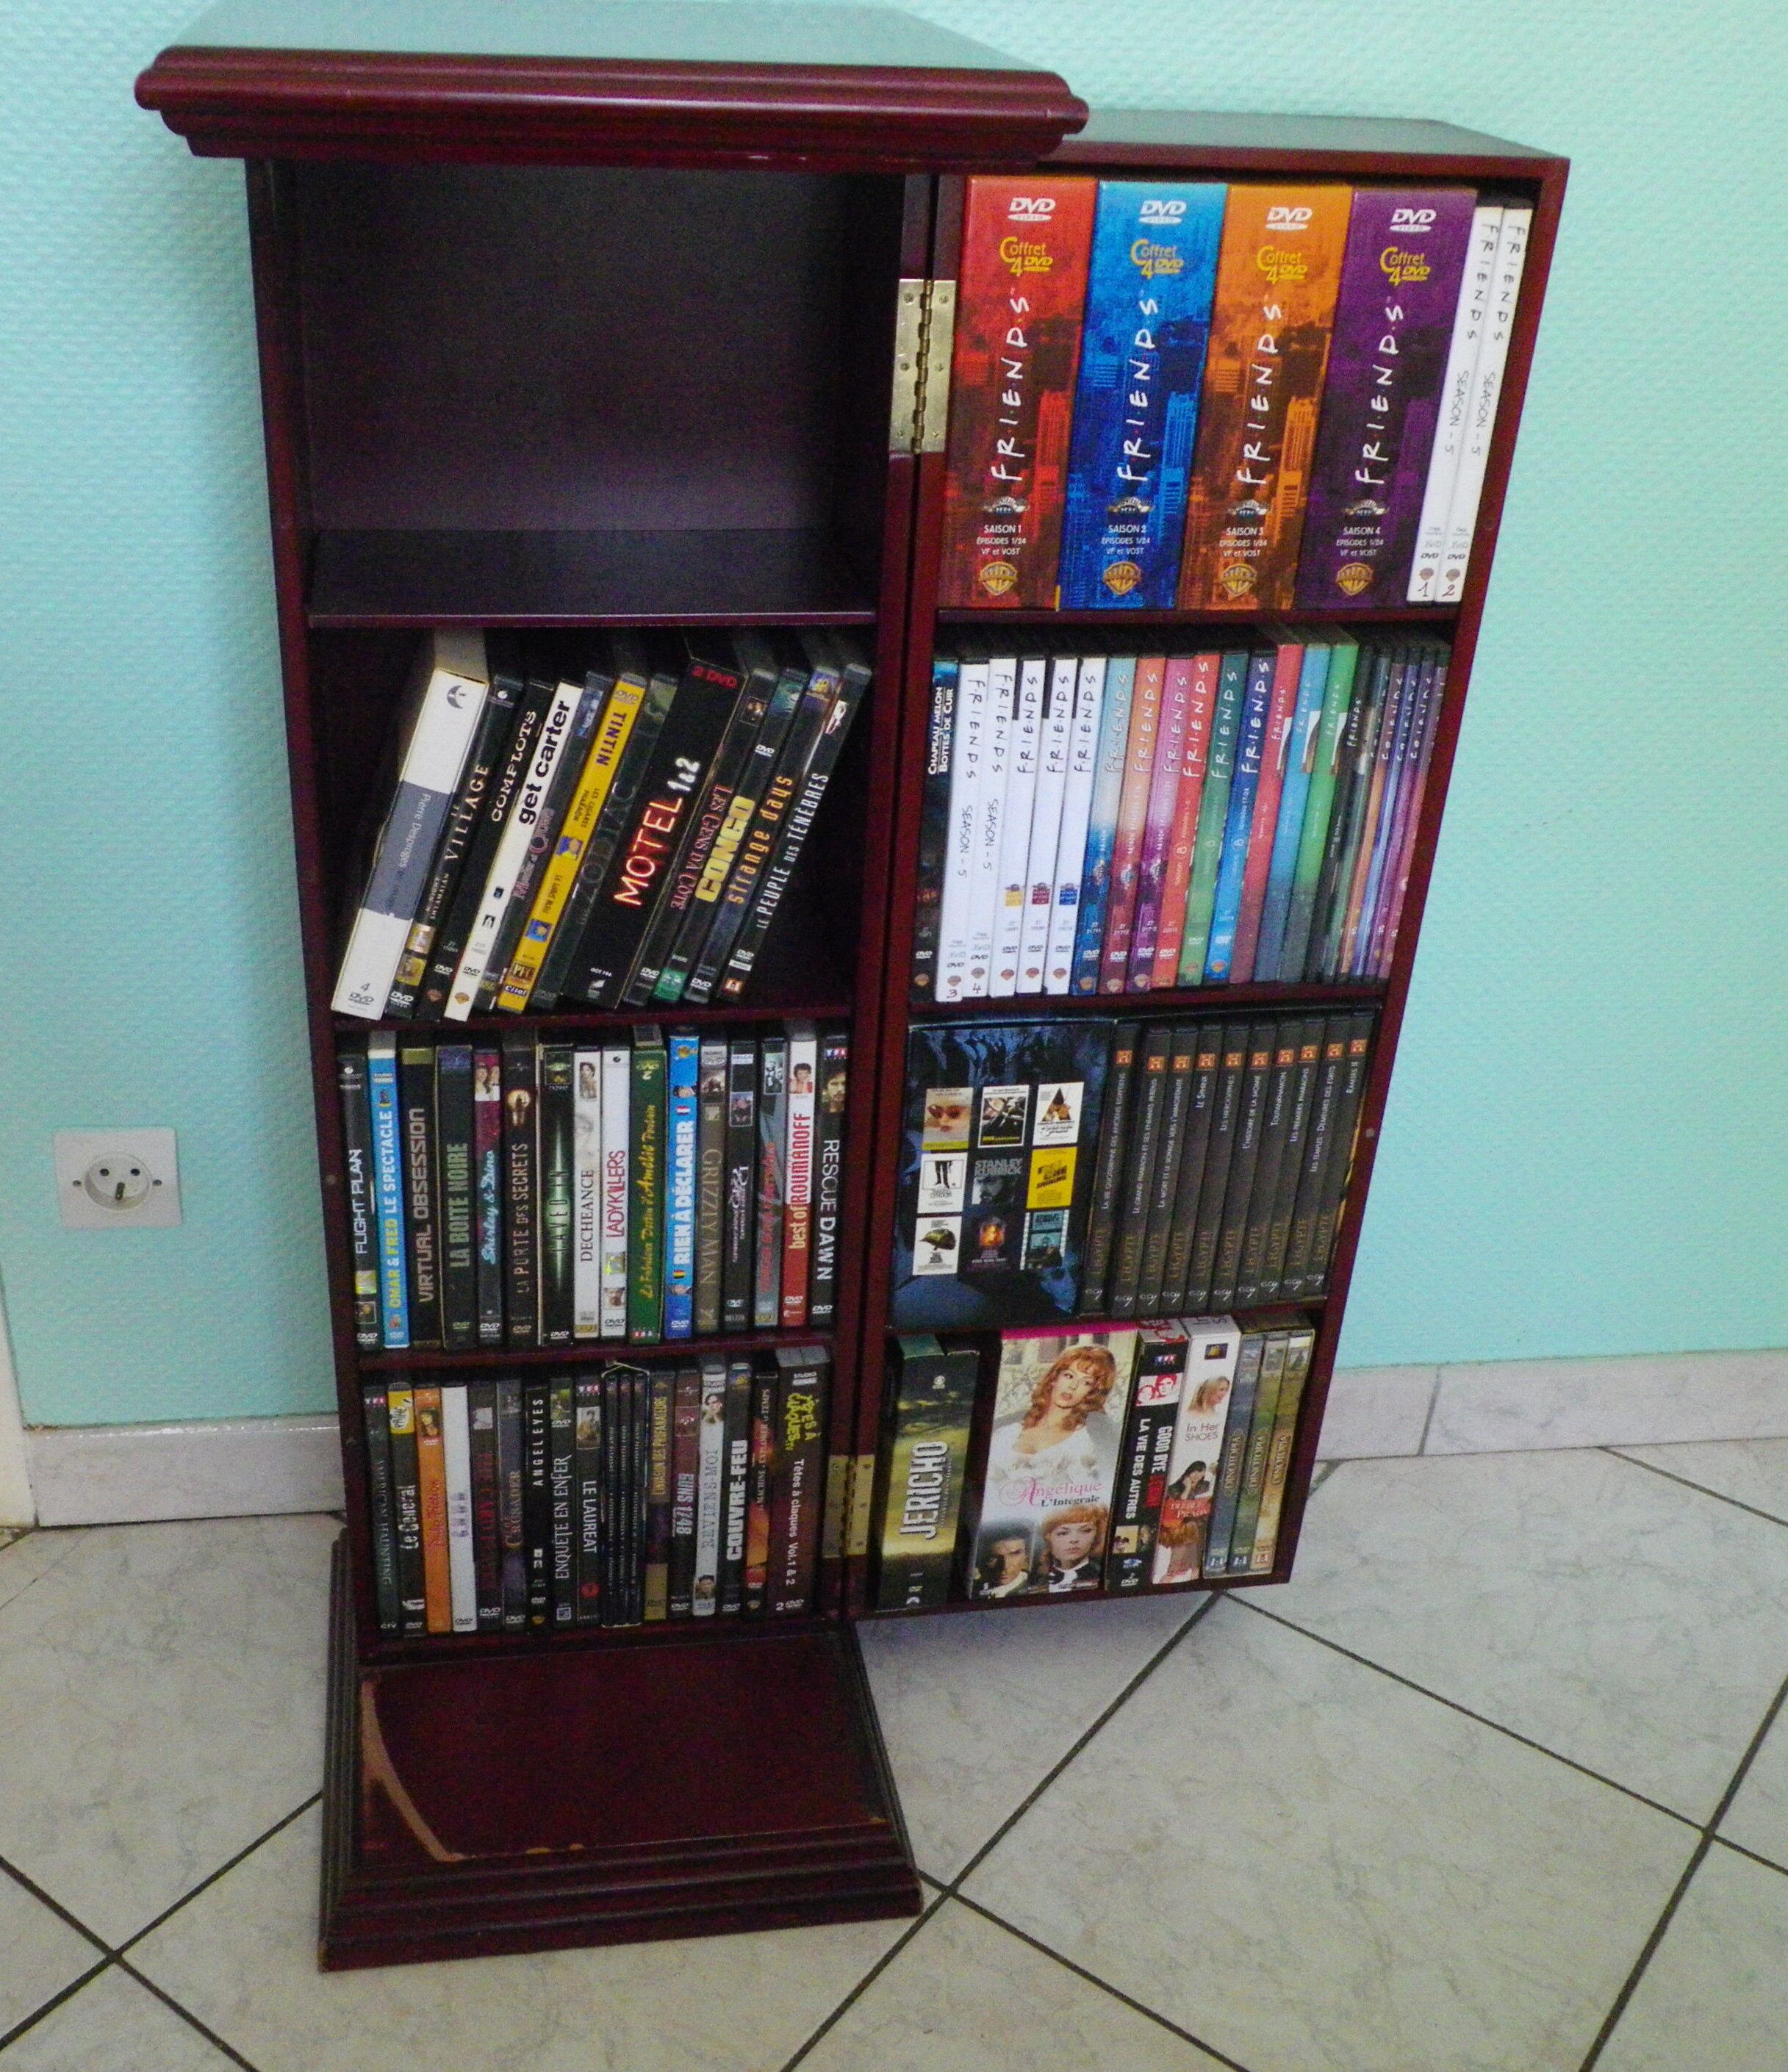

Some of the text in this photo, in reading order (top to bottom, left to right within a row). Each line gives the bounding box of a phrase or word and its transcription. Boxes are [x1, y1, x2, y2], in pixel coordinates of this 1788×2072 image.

[1008, 197, 1056, 212] DVD
[1141, 200, 1187, 215] DVD
[1267, 206, 1313, 222] DVD
[1391, 209, 1437, 224] DVD
[1000, 237, 1047, 262] Coffret
[1130, 239, 1178, 265] Coffret
[1256, 245, 1302, 272] Coffret
[1380, 247, 1425, 273] Coffret
[983, 524, 1022, 533] SAISON 1
[1107, 524, 1147, 533] SAISON 2
[1226, 526, 1257, 536] SAISON
[1343, 526, 1374, 536] SAISON
[981, 547, 1020, 555] VF et VOST
[1106, 547, 1144, 555] VF et VOST
[1242, 549, 1261, 558] VOST
[1340, 549, 1377, 557] VF VOST
[1418, 583, 1429, 597] 1
[1442, 583, 1456, 597] 2
[595, 711, 627, 766] TINTIN
[927, 686, 943, 775] CHAPEAU MELON
[938, 688, 955, 773] BOTTES DE CUIR
[491, 710, 537, 822] COMPLOTS
[518, 783, 542, 825] get
[535, 699, 570, 778] carter
[444, 764, 489, 860] VILLAGE
[398, 794, 431, 868] Pierre Desproges
[694, 813, 722, 851] GENS
[727, 774, 793, 905] strange days
[613, 796, 684, 908] MOTEL
[694, 795, 756, 903] CONGO
[756, 771, 830, 929] LE PEUPLE DES TÉNÈBRES
[736, 949, 755, 958] DVD
[360, 982, 370, 992] 4
[391, 990, 414, 1002] DVD
[946, 990, 957, 999] 3
[972, 983, 982, 995] 4
[480, 1148, 495, 1191] Dino
[974, 1157, 1023, 1168] STANLEY
[974, 1166, 1022, 1176] KUBRICK
[348, 1148, 368, 1254] FLIGHT PLAN
[408, 1107, 435, 1303] VIRTUAL OBSESSION
[446, 1143, 470, 1268] LA BOITE NOIRE
[606, 1149, 626, 1238] LADYKILLERS
[673, 1120, 695, 1265] RIEN DÉCLARER
[377, 1109, 401, 1309] OMAR & FRED LE SPECTACLE
[511, 1143, 531, 1294] LA PORTE DES SECRETS
[700, 1148, 724, 1285] GRIZZLY MAN
[789, 1203, 808, 1219] of
[816, 1140, 841, 1281] RESCUE DAWN
[481, 1207, 499, 1265] Shirley
[788, 1220, 807, 1250] best
[1155, 1425, 1174, 1453] GOOD
[1185, 1431, 1218, 1443] SHOES
[1186, 1422, 1221, 1432] In Her
[532, 1398, 544, 1487] ANGEL EYES
[791, 1458, 805, 1488] Têtes
[1125, 1418, 1151, 1520] LA VIE DES AUTRES
[1151, 1453, 1170, 1474] BYE
[726, 1439, 748, 1561] COUVRE-FEU
[899, 1440, 949, 1541] JERICHO
[553, 1501, 569, 1518] EN
[582, 1480, 597, 1554] LE LAUREAT
[788, 1499, 801, 1537] claques
[401, 1535, 420, 1550] Le
[552, 1522, 572, 1580] ENQUÊTE
[785, 1578, 795, 1586] 2
[786, 1569, 795, 1577] &
[776, 1602, 784, 1611] 2
